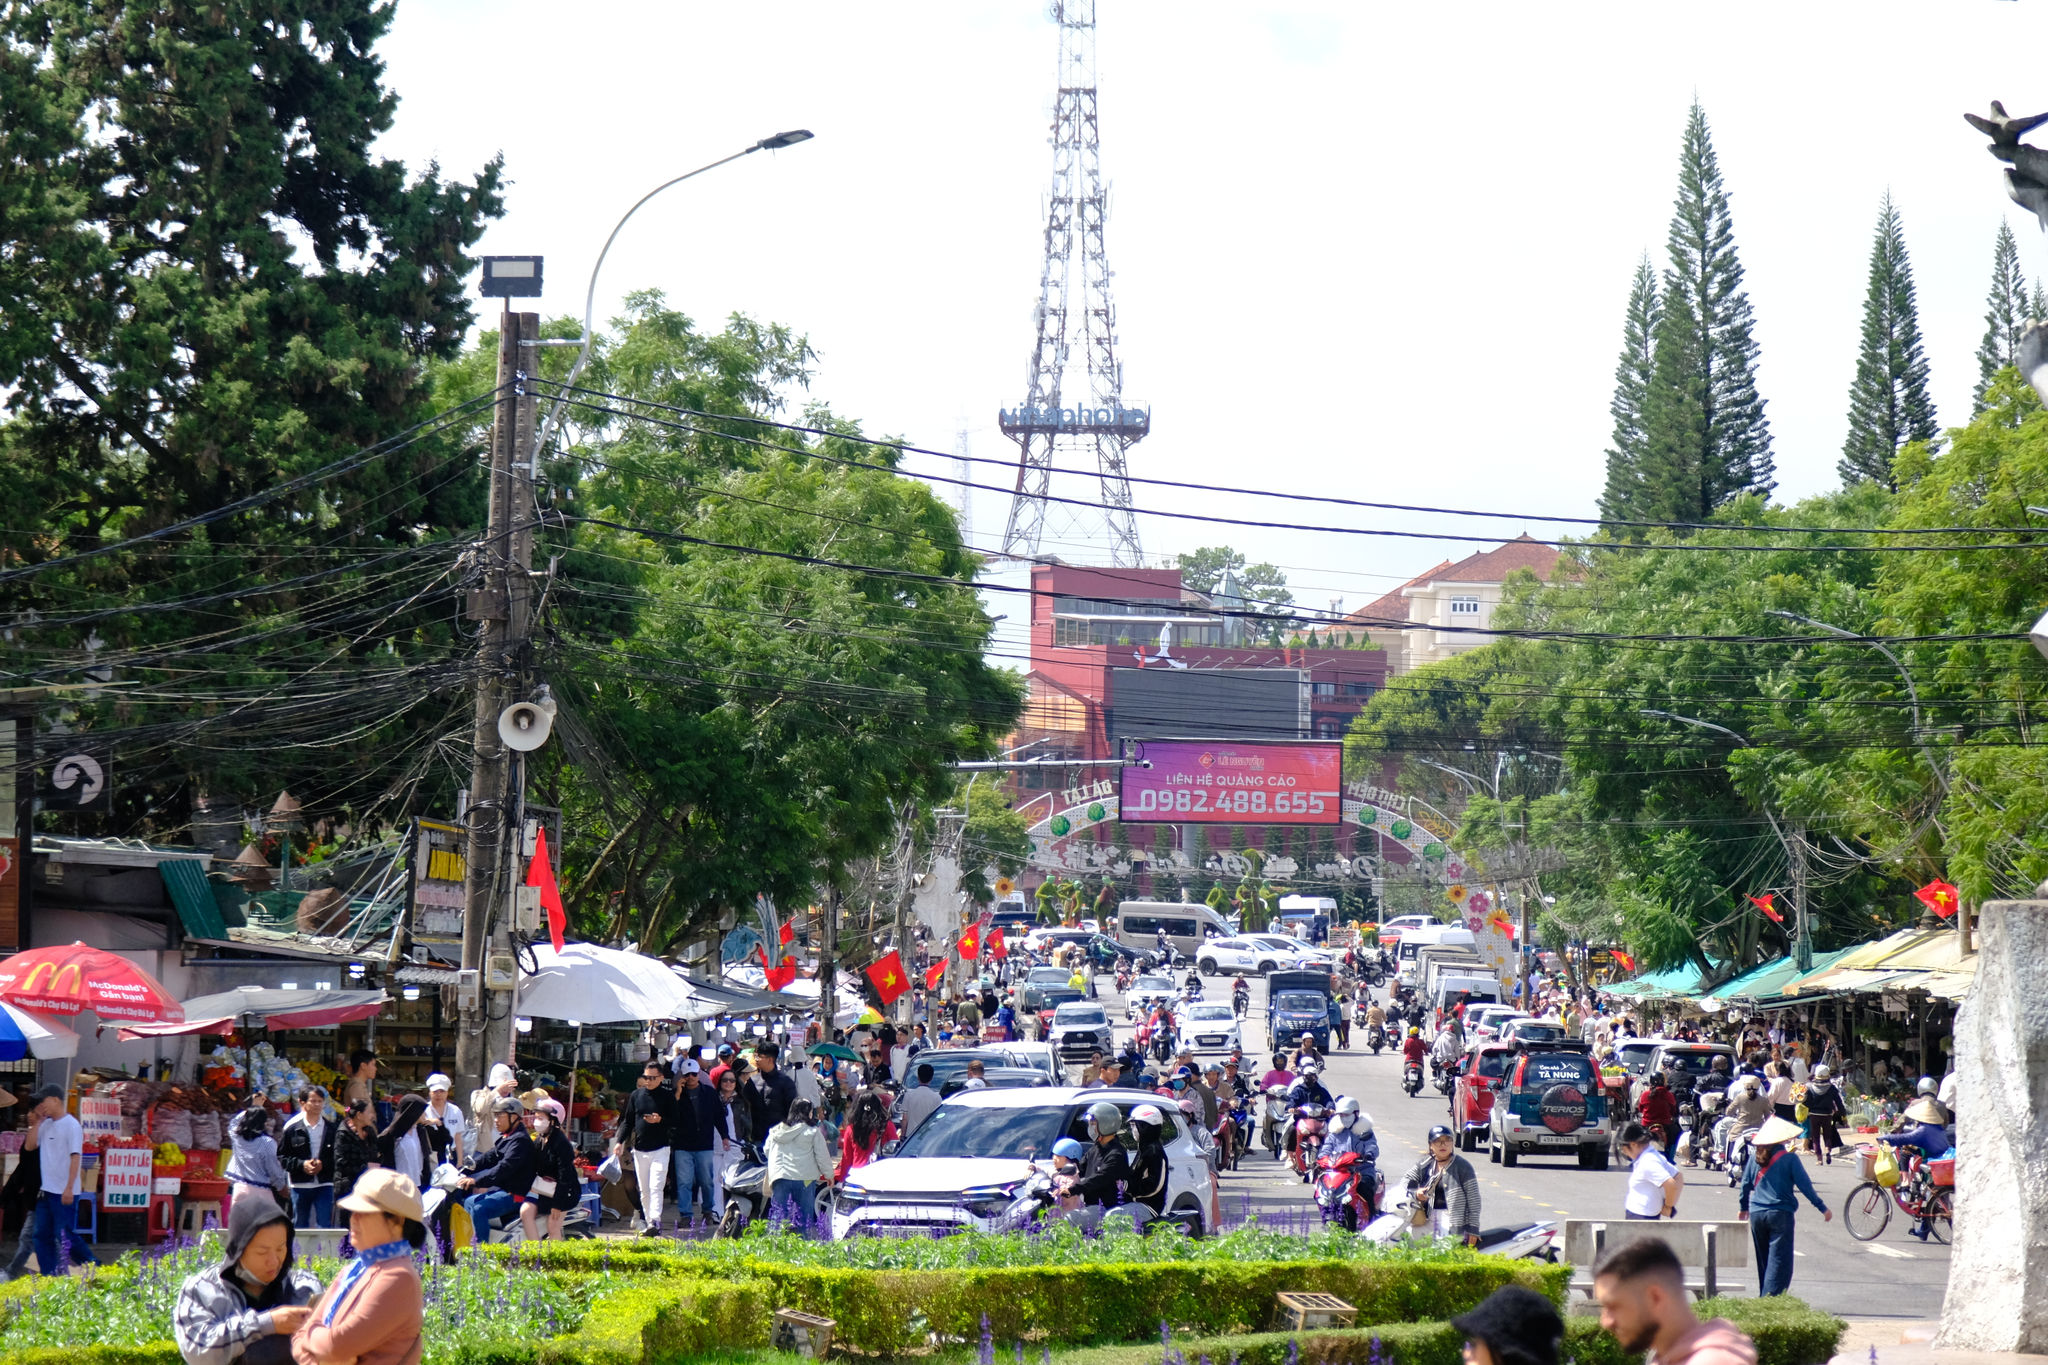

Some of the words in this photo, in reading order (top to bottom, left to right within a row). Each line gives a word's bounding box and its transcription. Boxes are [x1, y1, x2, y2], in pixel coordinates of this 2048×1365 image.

[1000, 402, 1146, 430] vinaphone
[1166, 772, 1193, 785] LIÊN
[1196, 773, 1213, 787] HỆ
[1217, 772, 1264, 787] QUẢNG
[1140, 789, 1325, 814] 0982.488.655
[88, 981, 149, 992] McDonald's
[1553, 1071, 1580, 1079] NUNG
[1543, 1105, 1585, 1113] TERIOS
[108, 1152, 122, 1166] DÂU
[124, 1154, 136, 1167] TÂY
[129, 1173, 149, 1186] DÂU
[108, 1193, 131, 1205] KEM
[133, 1193, 147, 1205] BƠ
